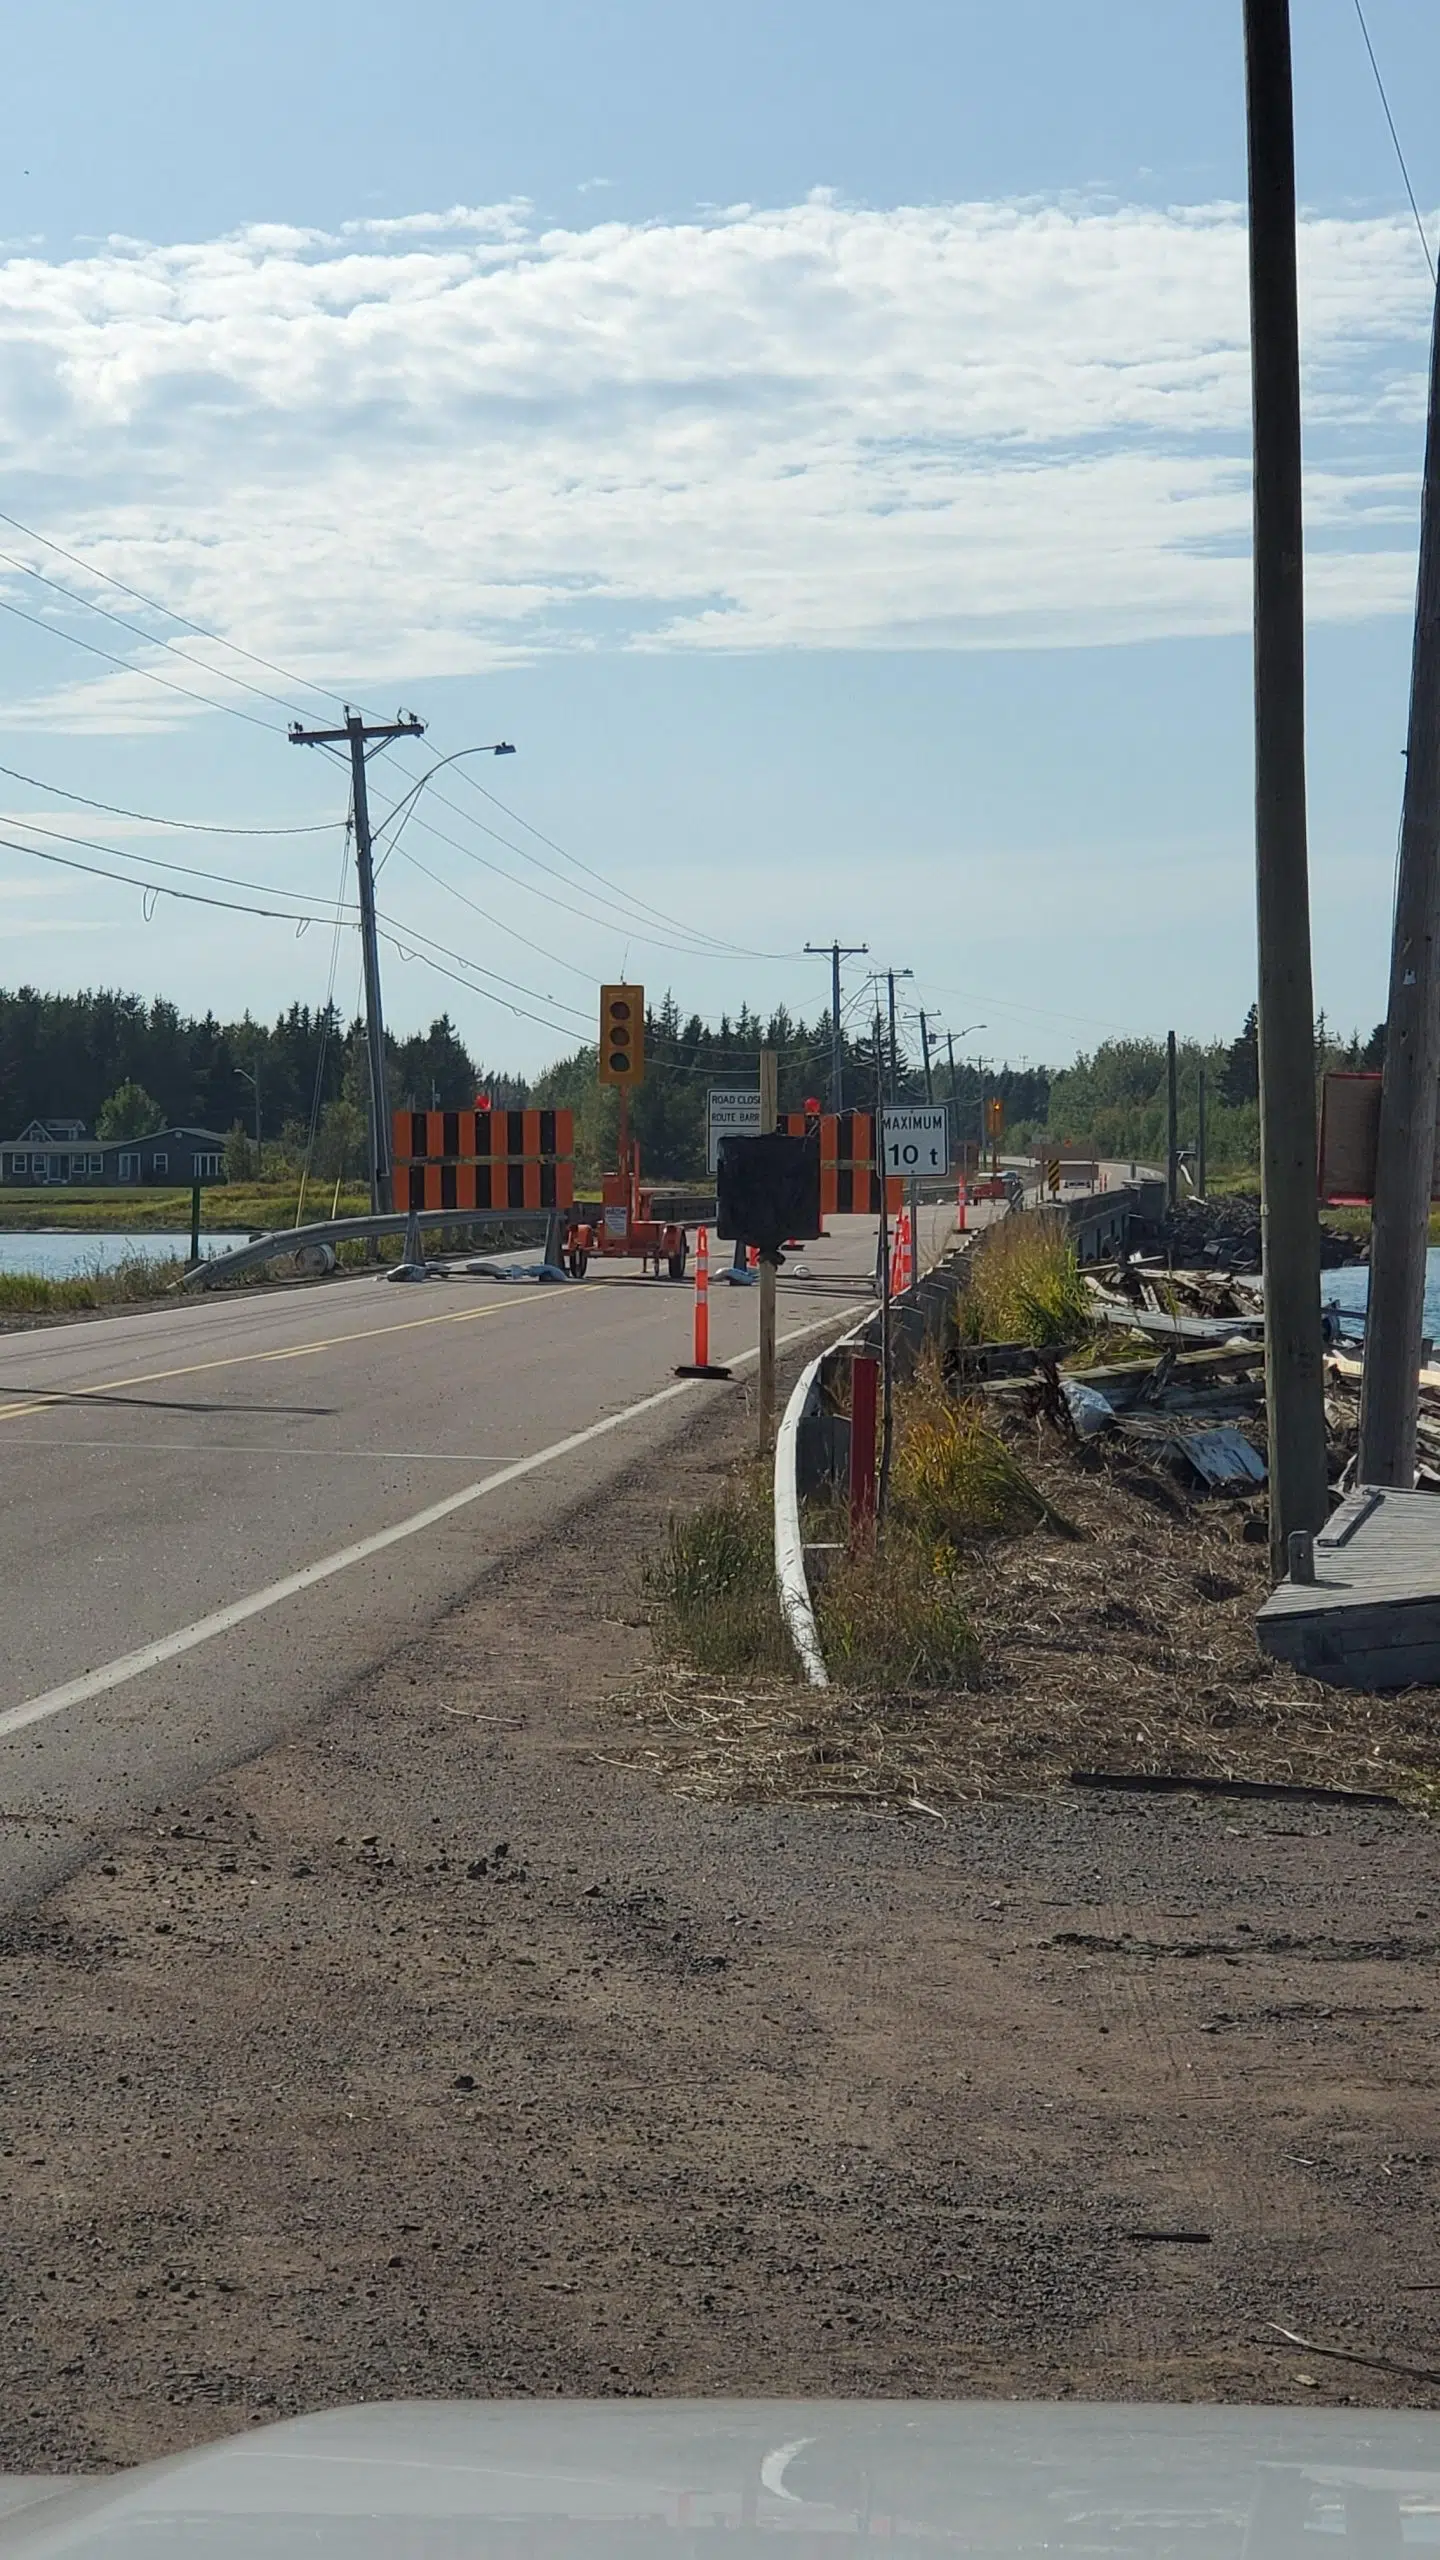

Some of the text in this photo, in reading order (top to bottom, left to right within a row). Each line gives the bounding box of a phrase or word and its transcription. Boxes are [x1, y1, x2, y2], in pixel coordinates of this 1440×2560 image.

[712, 1095, 760, 1104] ROAD CLOS
[712, 1113, 760, 1122] ROUTE BARR
[883, 1115, 942, 1130] MAXIMUM
[888, 1143, 938, 1166] 10 t
